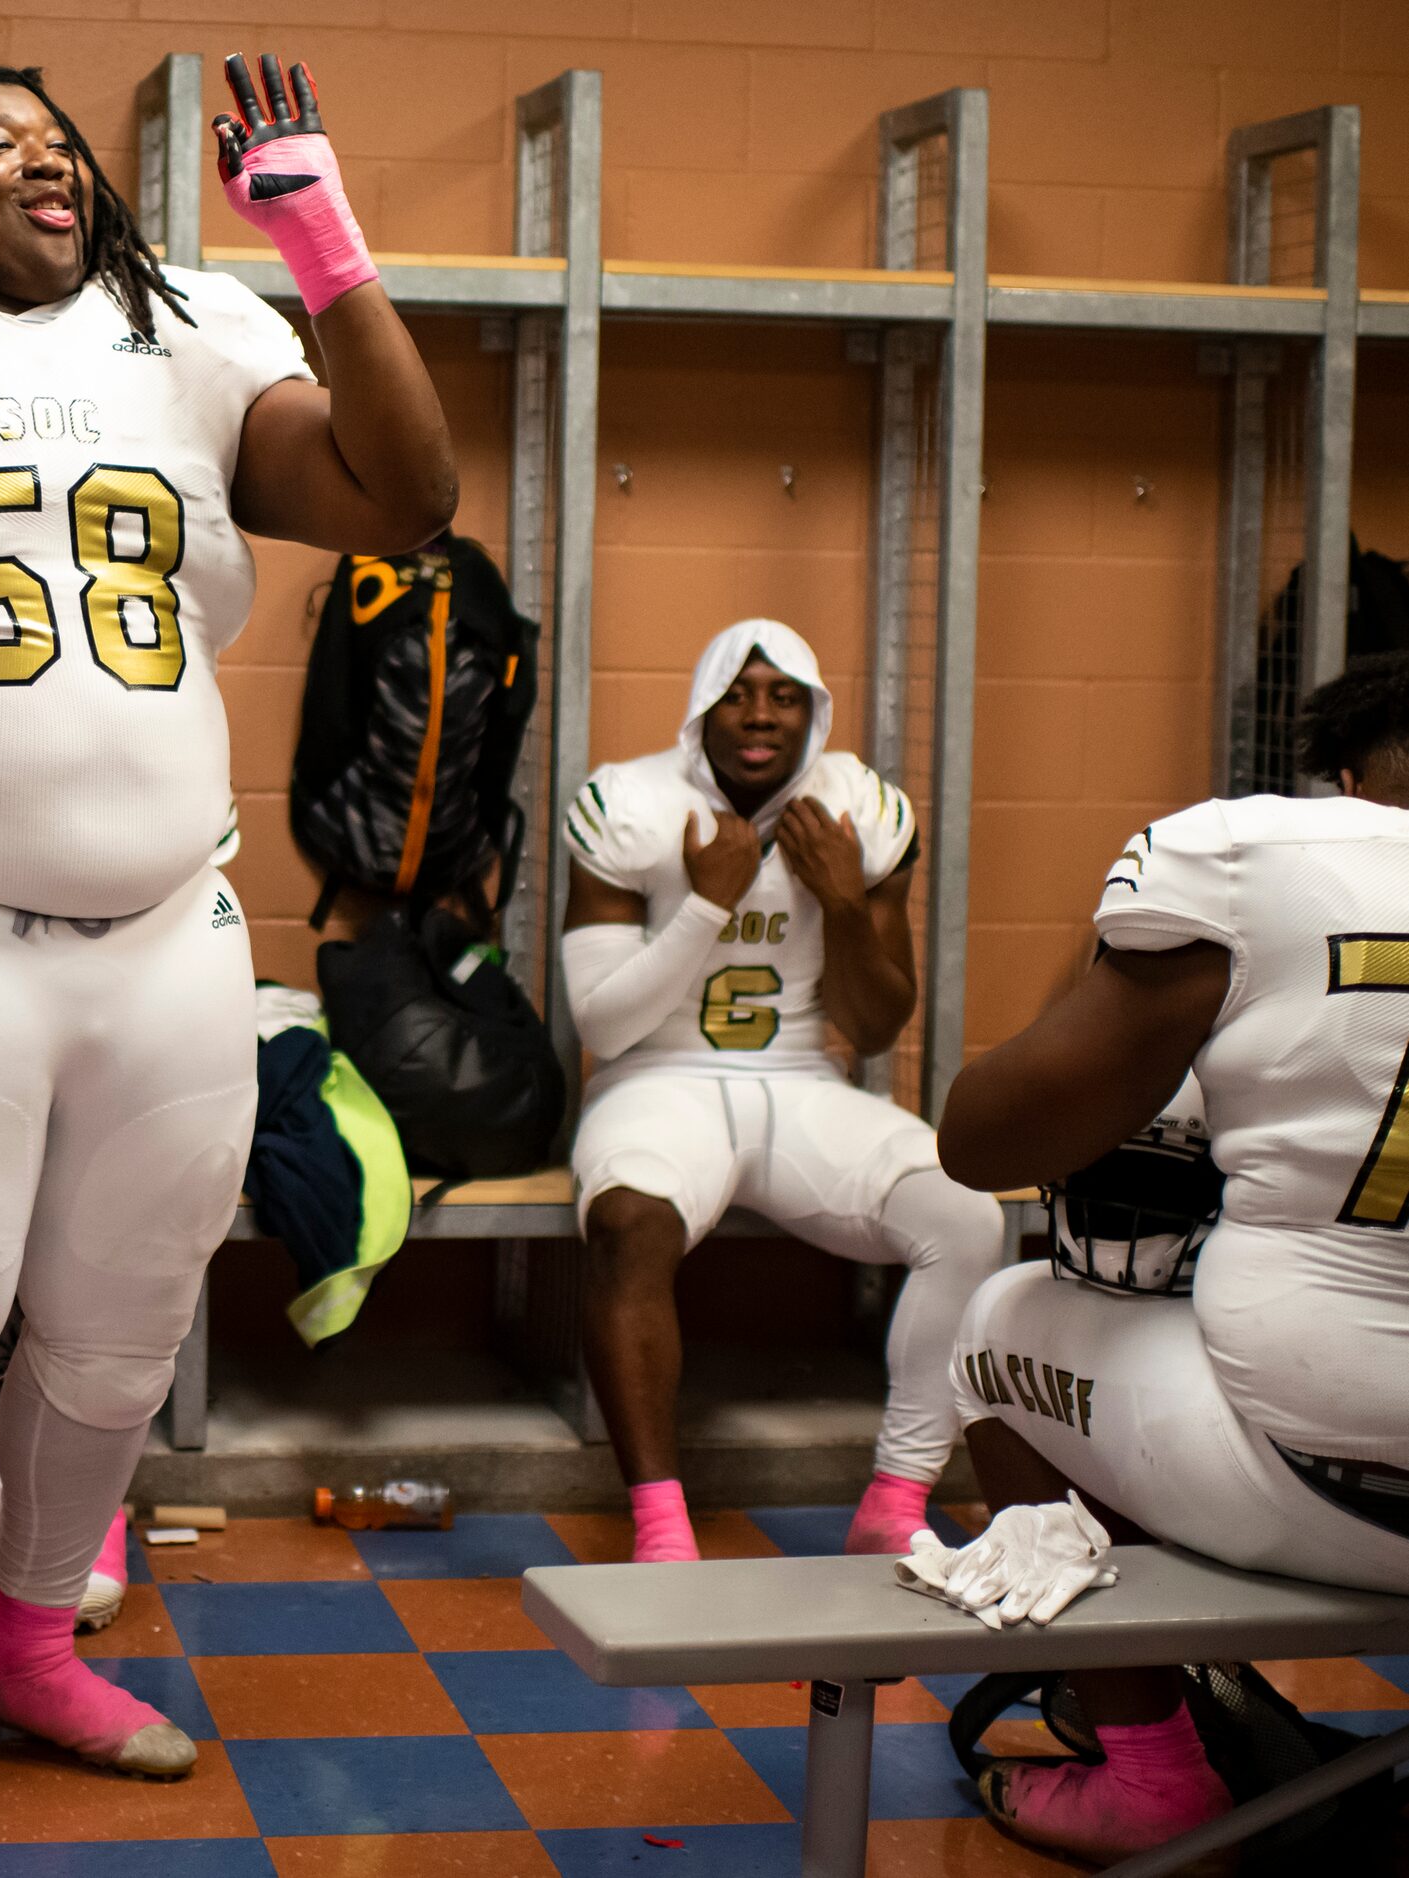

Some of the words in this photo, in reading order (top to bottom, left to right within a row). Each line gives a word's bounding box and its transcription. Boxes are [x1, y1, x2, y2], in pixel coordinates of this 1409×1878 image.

[111, 339, 172, 358] adidas
[700, 965, 784, 1052] 6
[1007, 1354, 1095, 1438] CLIFF
